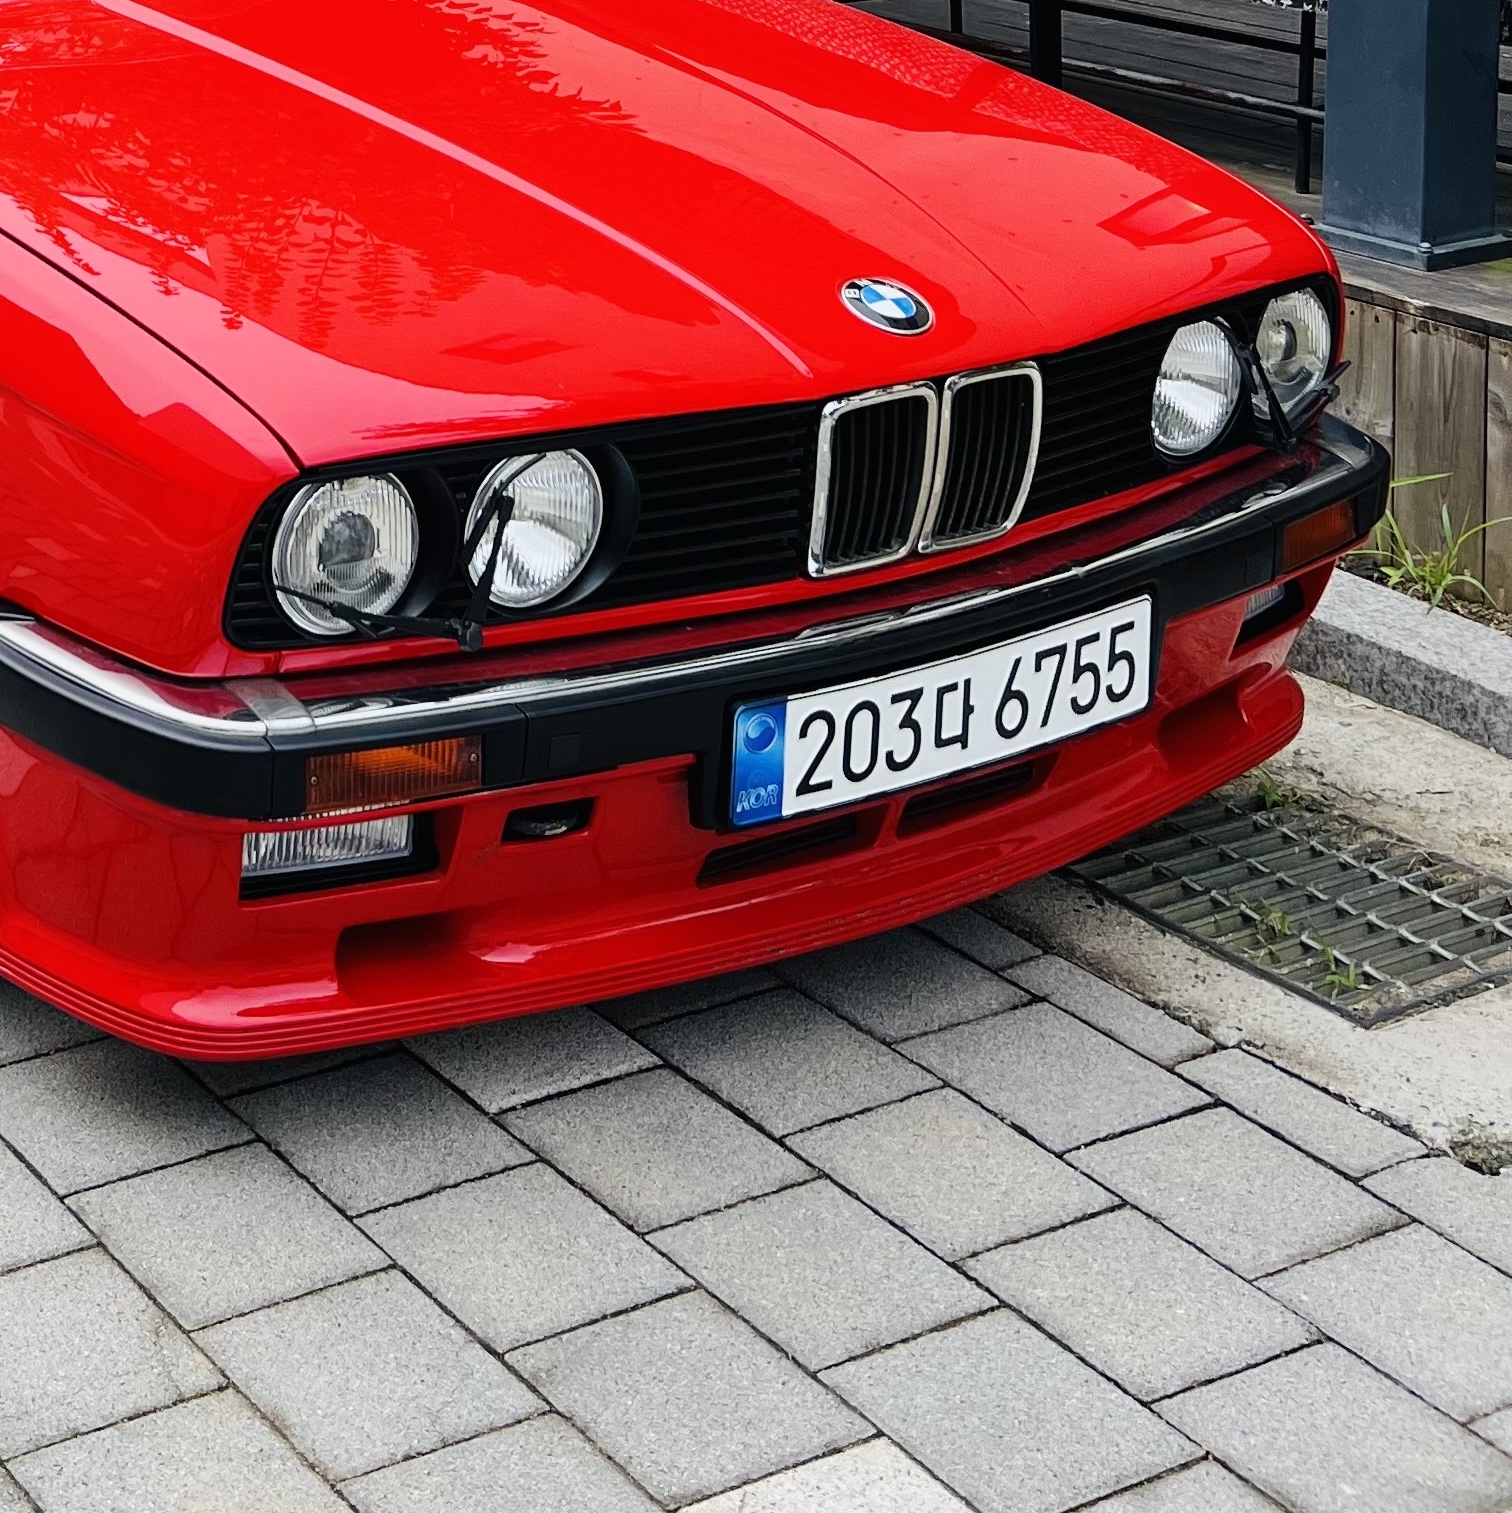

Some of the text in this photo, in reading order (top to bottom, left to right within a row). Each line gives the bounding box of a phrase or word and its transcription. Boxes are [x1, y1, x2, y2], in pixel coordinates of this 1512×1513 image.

[795, 620, 1136, 797] 203다 6755
[736, 784, 779, 813] KOR
